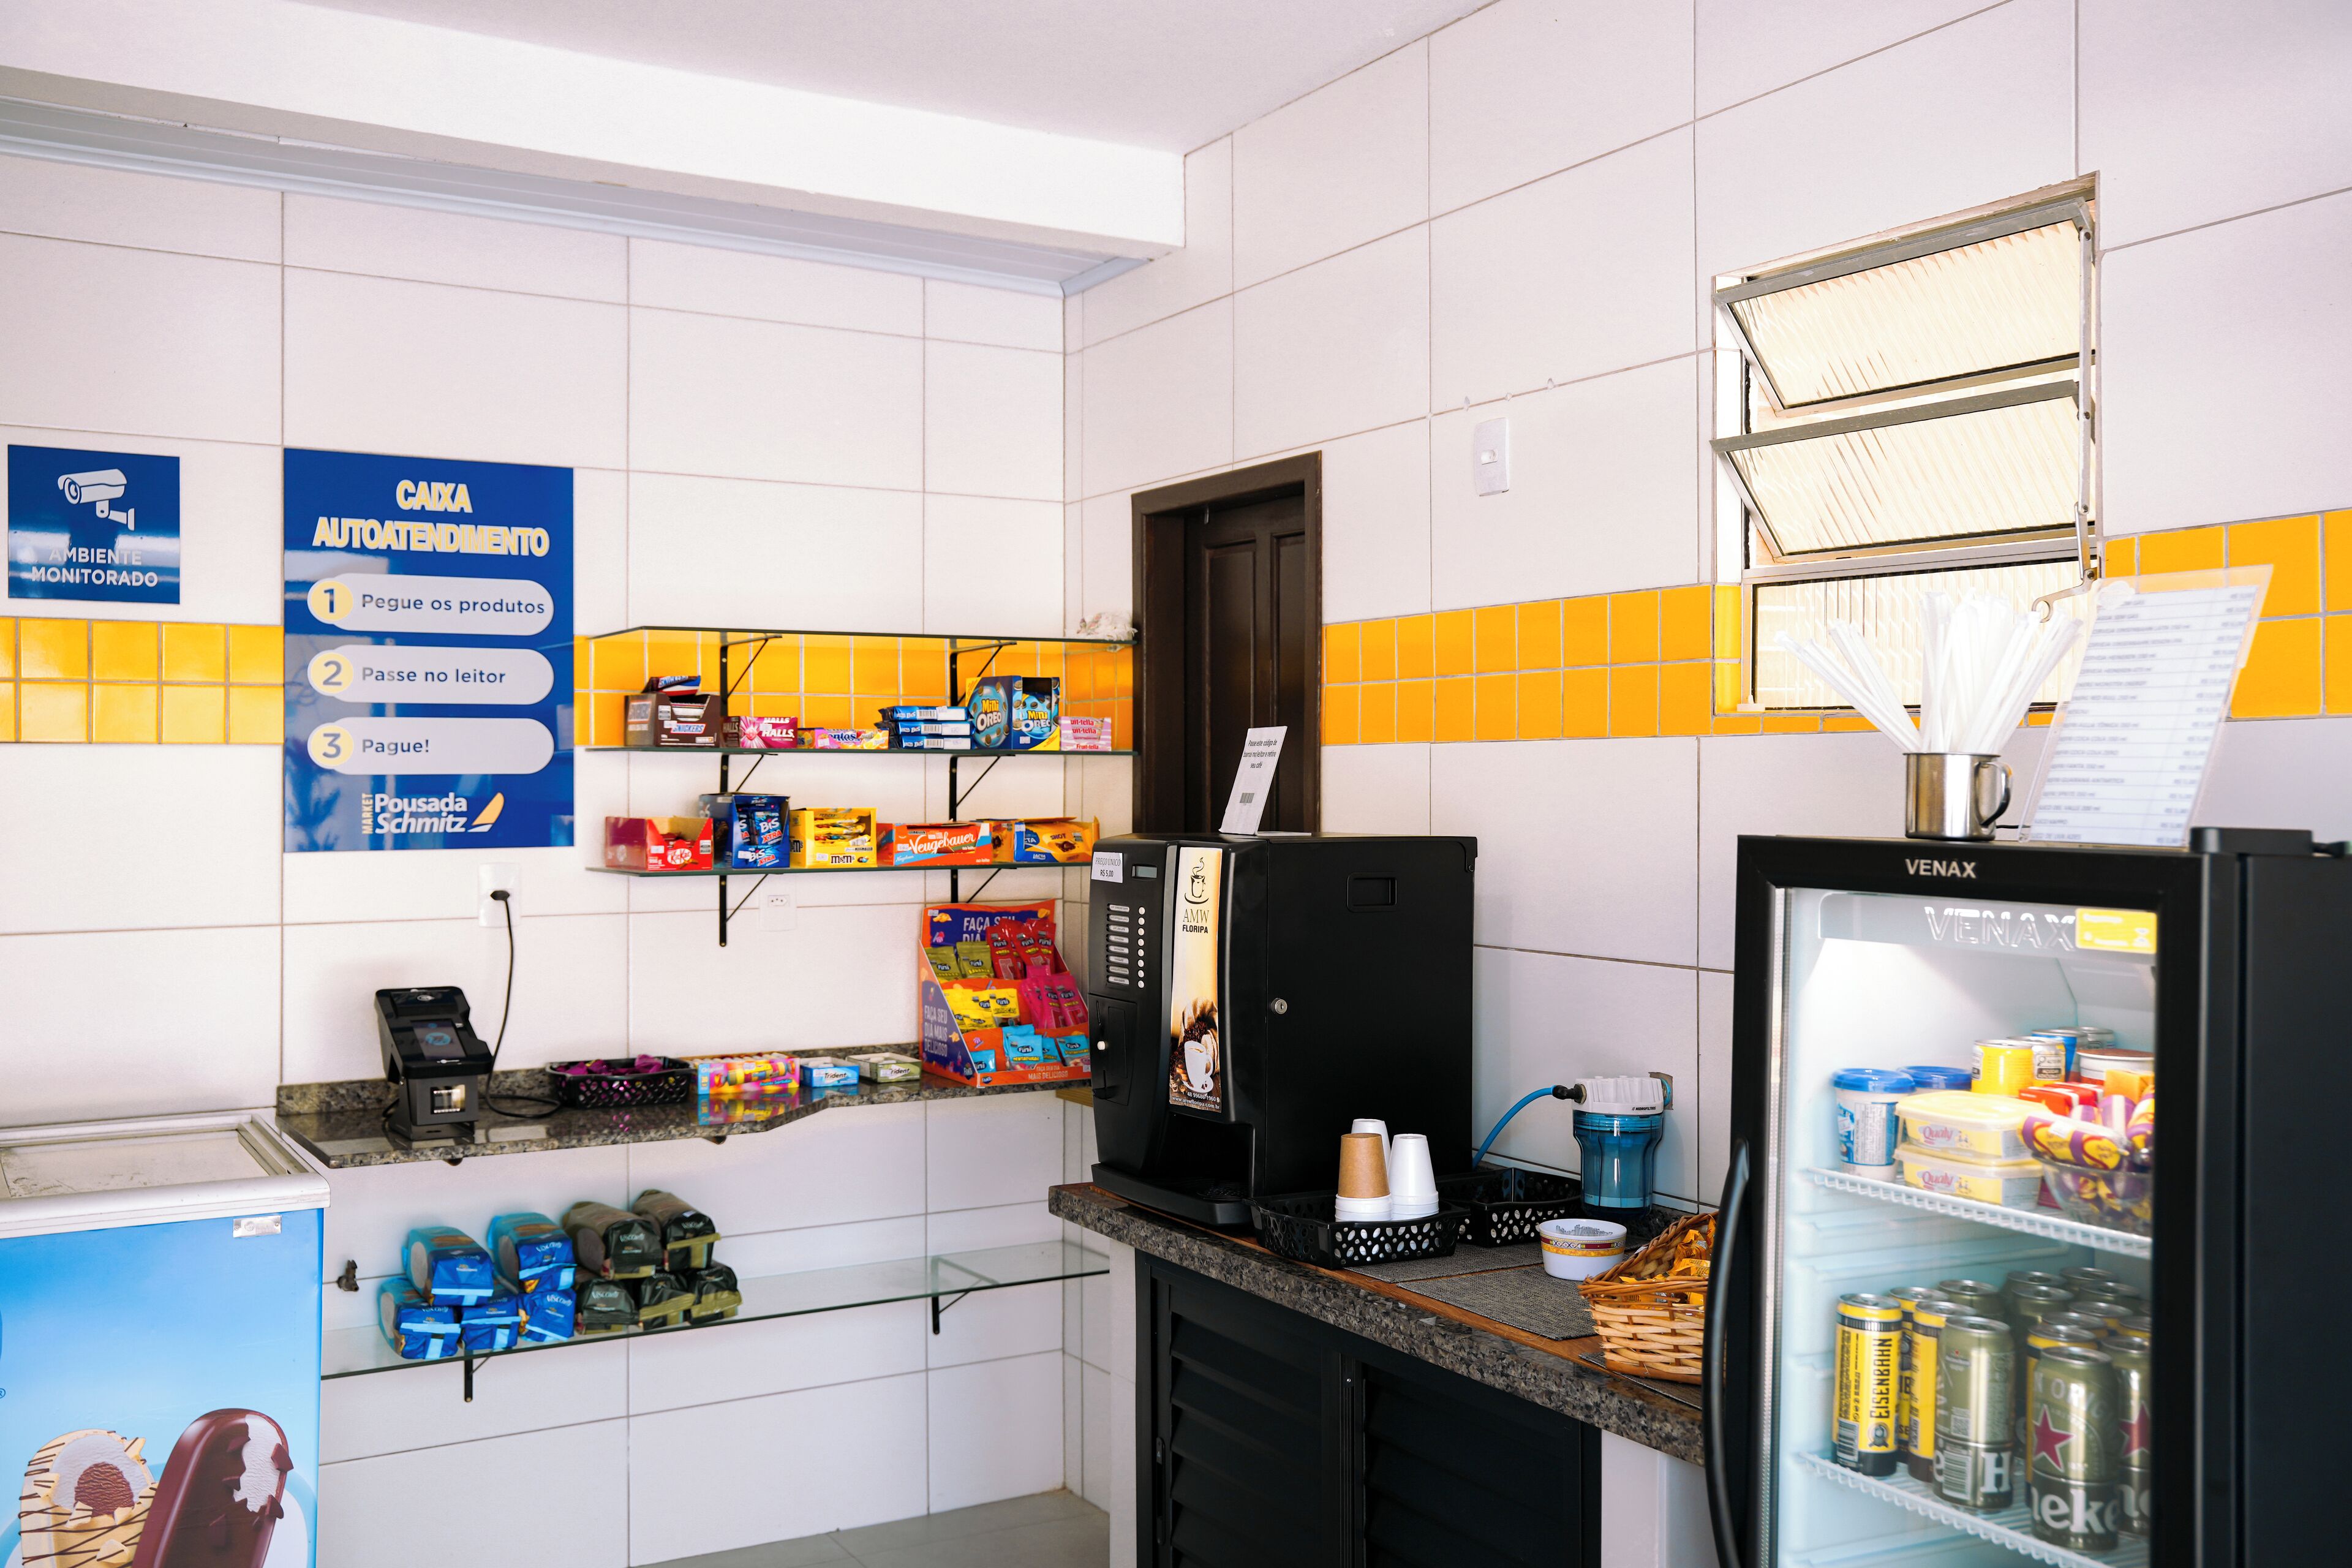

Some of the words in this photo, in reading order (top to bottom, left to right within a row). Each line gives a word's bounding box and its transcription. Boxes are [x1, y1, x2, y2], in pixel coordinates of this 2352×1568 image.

[396, 480, 473, 513] CAIXA
[312, 517, 550, 557] AUTOATENDIMENTO
[49, 547, 142, 565] AMBIENTE
[32, 566, 158, 587] MONITORADO
[323, 589, 335, 613] 1
[362, 594, 423, 611] Pegue
[431, 600, 451, 611] os
[459, 597, 545, 614] produtos
[322, 660, 342, 686] 2
[362, 667, 417, 681] Passe
[425, 671, 448, 682] no
[456, 669, 505, 683] leitor
[982, 699, 999, 713] Mini
[1028, 710, 1048, 720] Mini
[976, 712, 1002, 731] OREO
[762, 729, 794, 737] HALLS
[322, 733, 342, 758] 3
[362, 739, 429, 755] Pague!
[375, 792, 468, 813] Pousada
[361, 793, 374, 834] MARKET
[375, 811, 469, 834] Schmitz
[762, 829, 783, 845] XTRA
[758, 854, 775, 867] XTRA
[1095, 858, 1107, 867] PREÇO
[1107, 856, 1121, 867] ÚNICO
[1905, 859, 1977, 879] VENAX
[963, 917, 990, 933] FAÇA
[1183, 908, 1209, 924] AMW
[1182, 924, 1208, 933] FLORIPA
[1924, 906, 2076, 952] VENAX
[1923, 1126, 1954, 1141] Qualy
[1922, 1170, 1954, 1186] Qualy
[1870, 1338, 1893, 1419] EISENBAHN
